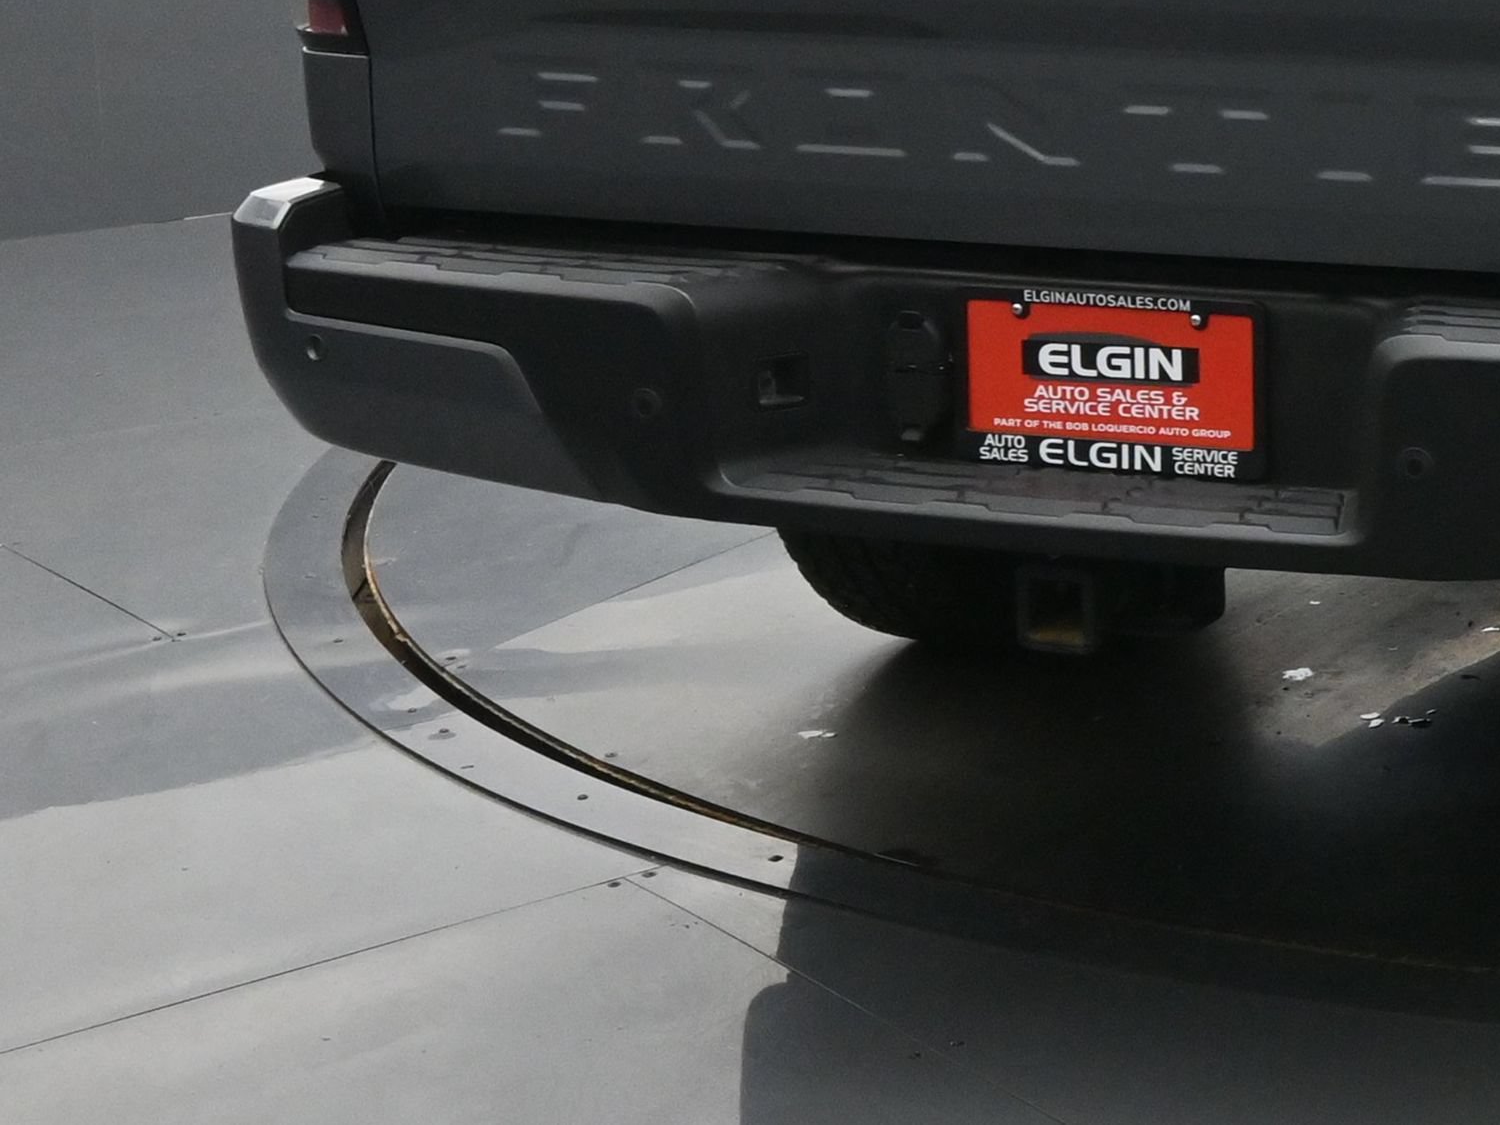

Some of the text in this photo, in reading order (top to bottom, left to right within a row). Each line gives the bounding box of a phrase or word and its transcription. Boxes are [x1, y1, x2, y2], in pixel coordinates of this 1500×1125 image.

[1024, 290, 1191, 312] ELGINAUTOSALES.COM
[1038, 343, 1182, 381] ELGIN
[1034, 385, 1187, 406] AUTO SALES &
[1024, 398, 1199, 421] SERVICE CENTER
[994, 417, 1021, 428] PART
[1024, 419, 1039, 428] OF
[1042, 420, 1062, 430] THE
[1065, 421, 1088, 431] BOB
[1159, 426, 1189, 437] AUTO
[1192, 428, 1231, 439] GROUP
[984, 434, 1025, 449] AUTO
[979, 447, 1029, 463] SALES
[1039, 438, 1162, 472] ELGIN
[1172, 447, 1238, 465] SERVICE
[1174, 461, 1235, 478] CENTER
